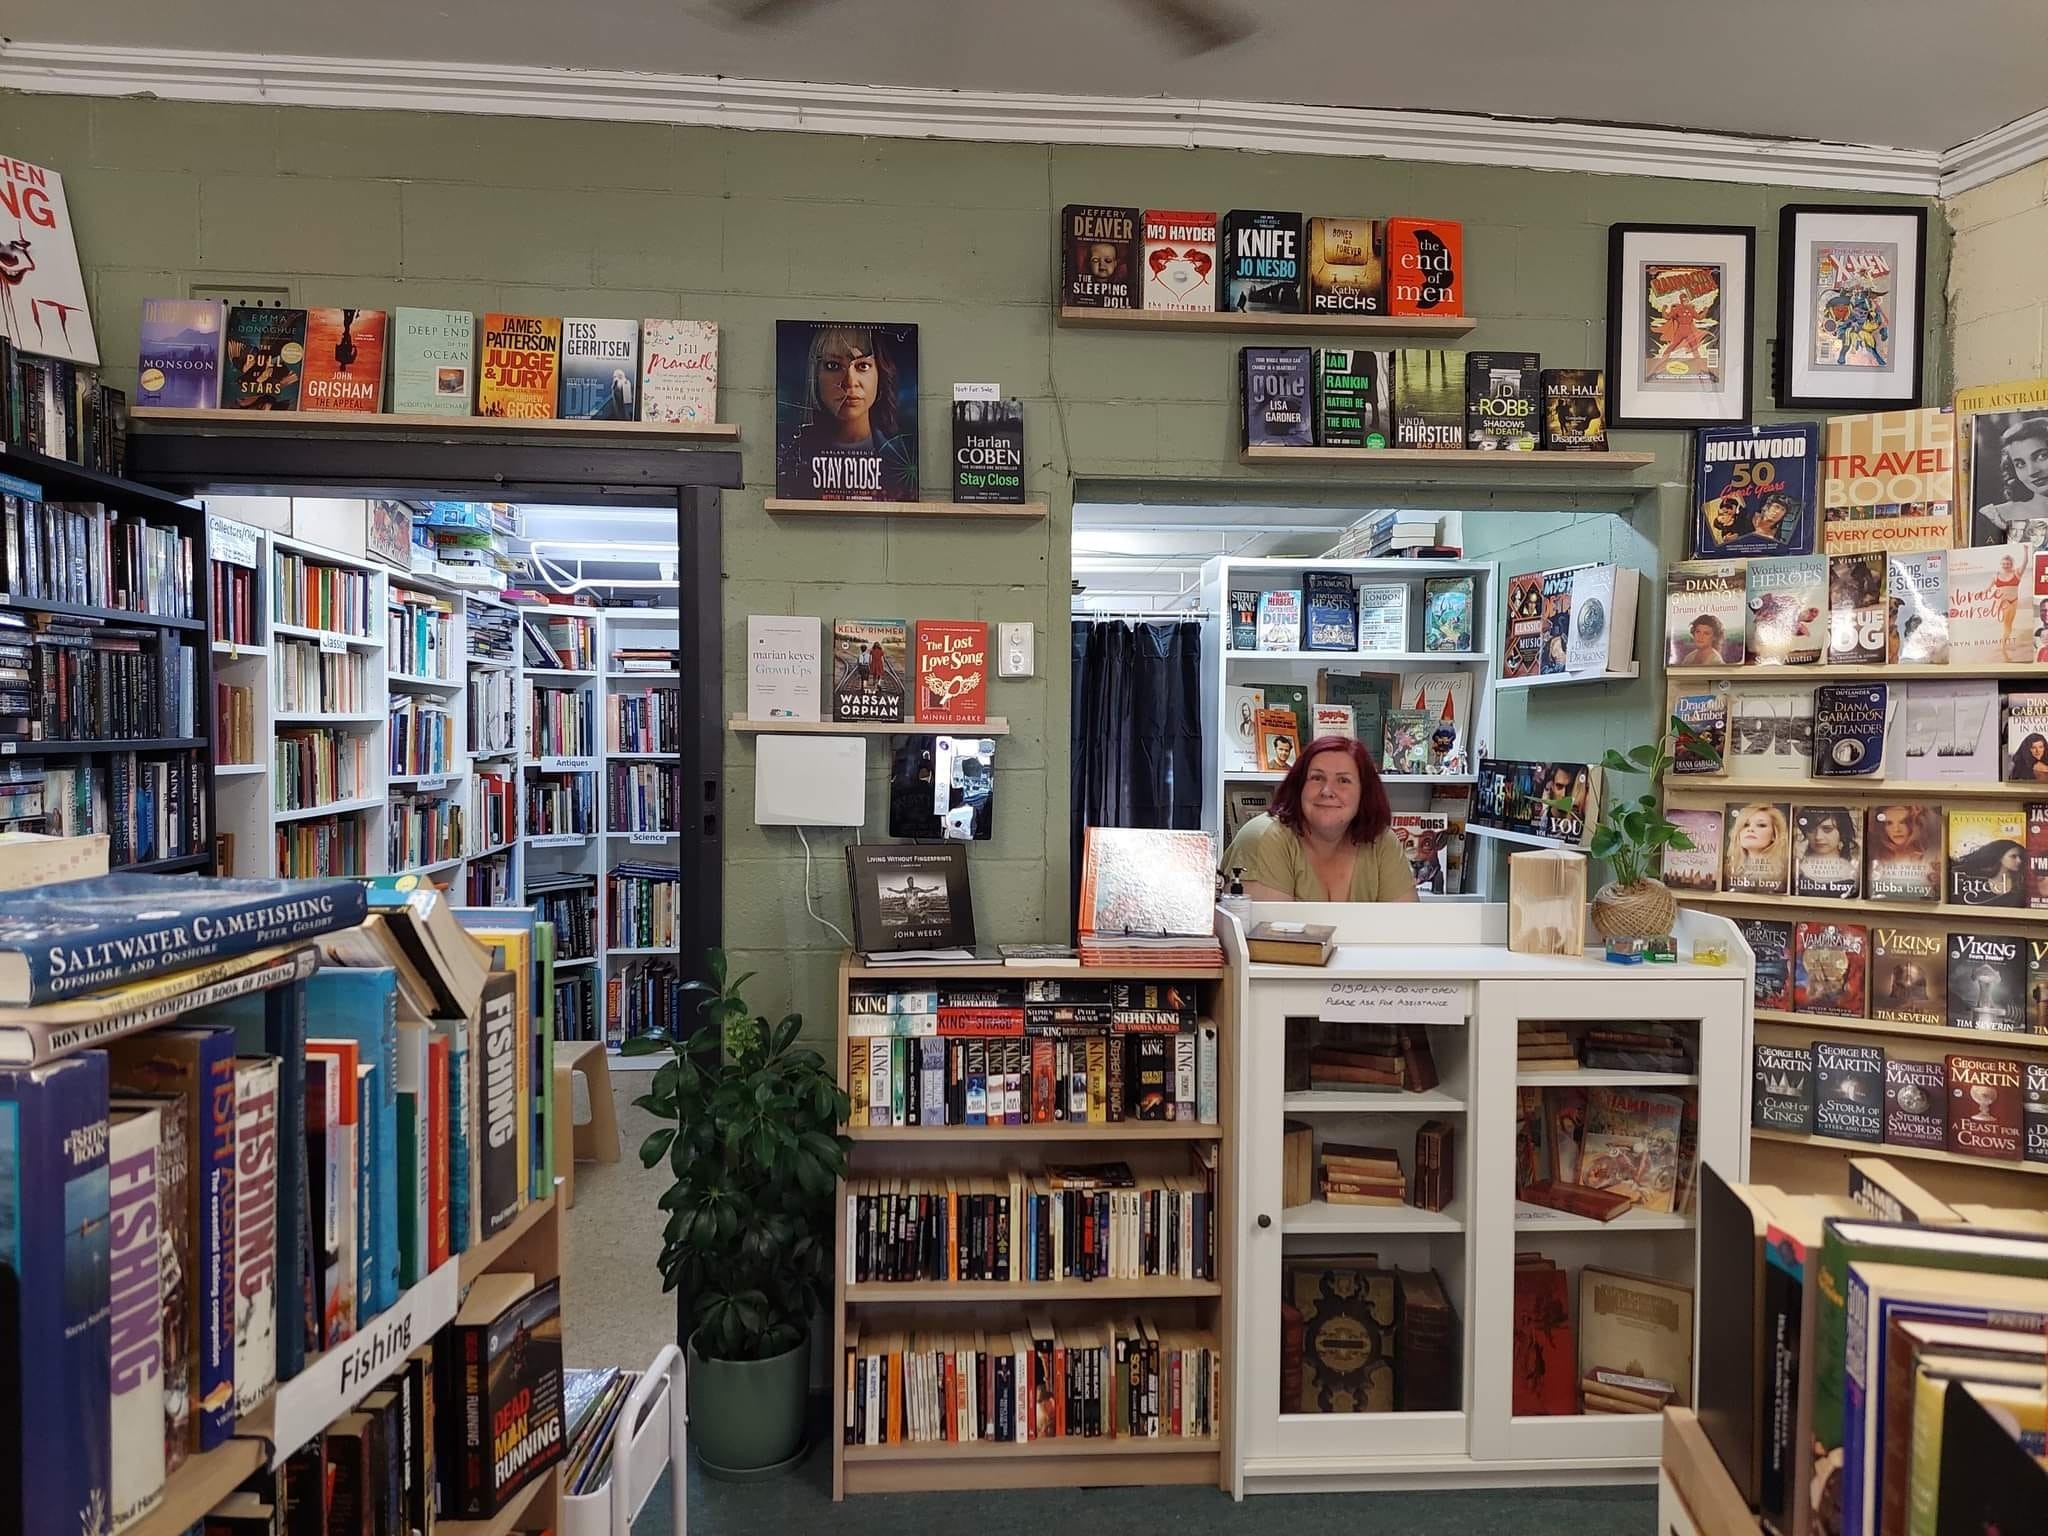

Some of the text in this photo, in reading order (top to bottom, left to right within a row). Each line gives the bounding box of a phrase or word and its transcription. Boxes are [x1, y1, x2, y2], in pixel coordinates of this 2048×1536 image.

[1080, 208, 1126, 219] JEFFERY
[1074, 216, 1133, 240] DEAVER
[1169, 225, 1216, 242] HAYDER
[1237, 228, 1296, 259] KNIFE
[1420, 239, 1440, 251] the
[1401, 248, 1451, 271] end
[1236, 258, 1252, 277] JO
[1078, 273, 1092, 283] THE
[1427, 272, 1441, 285] of
[1072, 282, 1128, 297] SLEEPING
[1331, 284, 1361, 297] Kathy
[1396, 285, 1455, 303] men
[1103, 296, 1132, 309] DOLL
[1315, 295, 1377, 311] REICHS
[31, 297, 84, 354] IT
[251, 313, 288, 323] EMMA
[446, 313, 470, 325] THE
[238, 324, 298, 335] DONOGHUE
[408, 325, 470, 338] DEEP END
[502, 317, 542, 335] JAMES
[568, 322, 597, 340] TESS
[486, 331, 556, 352] PATTERSON
[567, 339, 631, 358] GERRITSEN
[246, 353, 283, 368] PULL
[423, 349, 469, 361] OCEAN
[484, 350, 554, 371] JUDGE
[647, 351, 713, 374] Mansell
[1326, 355, 1346, 368] IAN
[143, 359, 214, 371] MONSOON
[332, 371, 352, 381] JOHN
[496, 370, 552, 389] JURY
[1326, 375, 1369, 390] RANKIN
[241, 383, 281, 394] STARS
[308, 380, 373, 400] GRISHAM
[1252, 374, 1305, 403] gone
[1572, 385, 1602, 396] HALL
[315, 398, 364, 409] THE APPEAL
[507, 401, 551, 418] GROSS
[1269, 399, 1288, 411] LISA
[1326, 398, 1353, 408] RATHER
[1479, 398, 1529, 417] ROBB
[1961, 397, 1985, 411] THE
[1265, 412, 1301, 424] GARDNER
[1326, 417, 1361, 429] THE DEVIL
[1399, 417, 1425, 426] LINDA
[1483, 419, 1525, 429] SHADOWS
[1398, 425, 1462, 443] FAIRSTEIN
[1495, 428, 1522, 436] DEATH
[1551, 433, 1605, 445] Disappeared
[1827, 411, 1952, 456] THE
[967, 435, 1010, 449] Harlan
[1705, 437, 1806, 462] HOLLYWOOD
[957, 448, 1021, 465] COBEN
[1829, 449, 1952, 479] TRAVEL
[811, 456, 882, 490] STAY CLOSE
[959, 472, 1019, 489] Stay Close
[1732, 461, 1775, 488] 50
[1825, 473, 1953, 506] BOOK
[1826, 526, 1948, 542] EVERY COUNTRY
[1686, 578, 1728, 592] DIANA
[1365, 593, 1401, 602] LONDON
[1236, 601, 1256, 612] KING
[1673, 604, 1738, 614] Drums Autumn
[1263, 613, 1298, 625] DUNE
[838, 626, 904, 635] KELLY RIMMER
[926, 634, 974, 652] The Lost
[1520, 637, 1541, 649] MUSIC
[752, 650, 786, 661] marian
[922, 650, 984, 673] Love Song
[840, 694, 900, 706] WARSAW
[1834, 702, 1869, 712] DIANA
[840, 705, 899, 717] ORPHAN
[922, 713, 981, 722] MINNIE DARKE
[1818, 710, 1884, 722] GABALDON
[555, 759, 589, 769] Antiques
[1420, 819, 1444, 830] DOGS
[1550, 817, 1582, 835] YOU
[633, 833, 665, 842] Science
[1730, 876, 1782, 889] libba bray
[1800, 880, 1854, 893] libba bray
[1875, 881, 1932, 894] libba bray
[49, 895, 334, 977] SALTWATER GAMEFISHING
[256, 926, 288, 943] PETER
[893, 929, 942, 939] JOHN WEEKS
[1878, 928, 1941, 954] VIKING
[1957, 935, 2016, 960] VIKING
[50, 942, 219, 993] OFFSHORE AND ONSHORE
[51, 1030, 80, 1051] RON
[151, 989, 210, 1020] COMPLETE
[211, 981, 239, 1002] BOOK
[242, 977, 255, 993] OF
[256, 966, 294, 989] FISHING
[855, 996, 887, 1013] KING
[1378, 998, 1448, 1007] FOR ASSISTANCE
[939, 1015, 966, 1029] KING
[1156, 1012, 1180, 1025] KING
[1877, 1010, 1940, 1024] TIM SEVERIN
[1955, 1018, 2014, 1032] TIM SEVERIN
[1089, 1041, 1104, 1072] KING
[1141, 1043, 1163, 1056] KING
[1177, 1041, 1193, 1072] KING
[1758, 1045, 1794, 1058] GEORGE
[1817, 1043, 1859, 1058] GEORGE
[851, 1044, 867, 1075] KING
[872, 1044, 889, 1077] KING
[1758, 1055, 1812, 1073] MARTIN
[1817, 1054, 1881, 1074] MARTIN
[1886, 1060, 1924, 1073] GEORGE
[1951, 1056, 1996, 1071] GEORGE
[486, 991, 515, 1149] FISHING
[1951, 1067, 2020, 1088] MARTIN
[1885, 1070, 1944, 1088] MARTIN
[1764, 1096, 1798, 1111] CLASH
[1826, 1099, 1865, 1115] STORM
[1762, 1106, 1804, 1124] KINGS
[1817, 1109, 1880, 1129] SWORDS
[1895, 1110, 1930, 1125] STORM
[1887, 1119, 1942, 1136] SWORDS
[1961, 1118, 2020, 1137] FEAST FOR
[1957, 1130, 2015, 1150] CROWS
[239, 1089, 276, 1298] FISHING
[110, 1147, 160, 1397] FISHING
[340, 1312, 412, 1395] Fishing
[493, 1386, 531, 1432] DEAD
[465, 1393, 479, 1447] RUNNING
[494, 1414, 528, 1458] MAN
[495, 1415, 560, 1489] RUNNING
